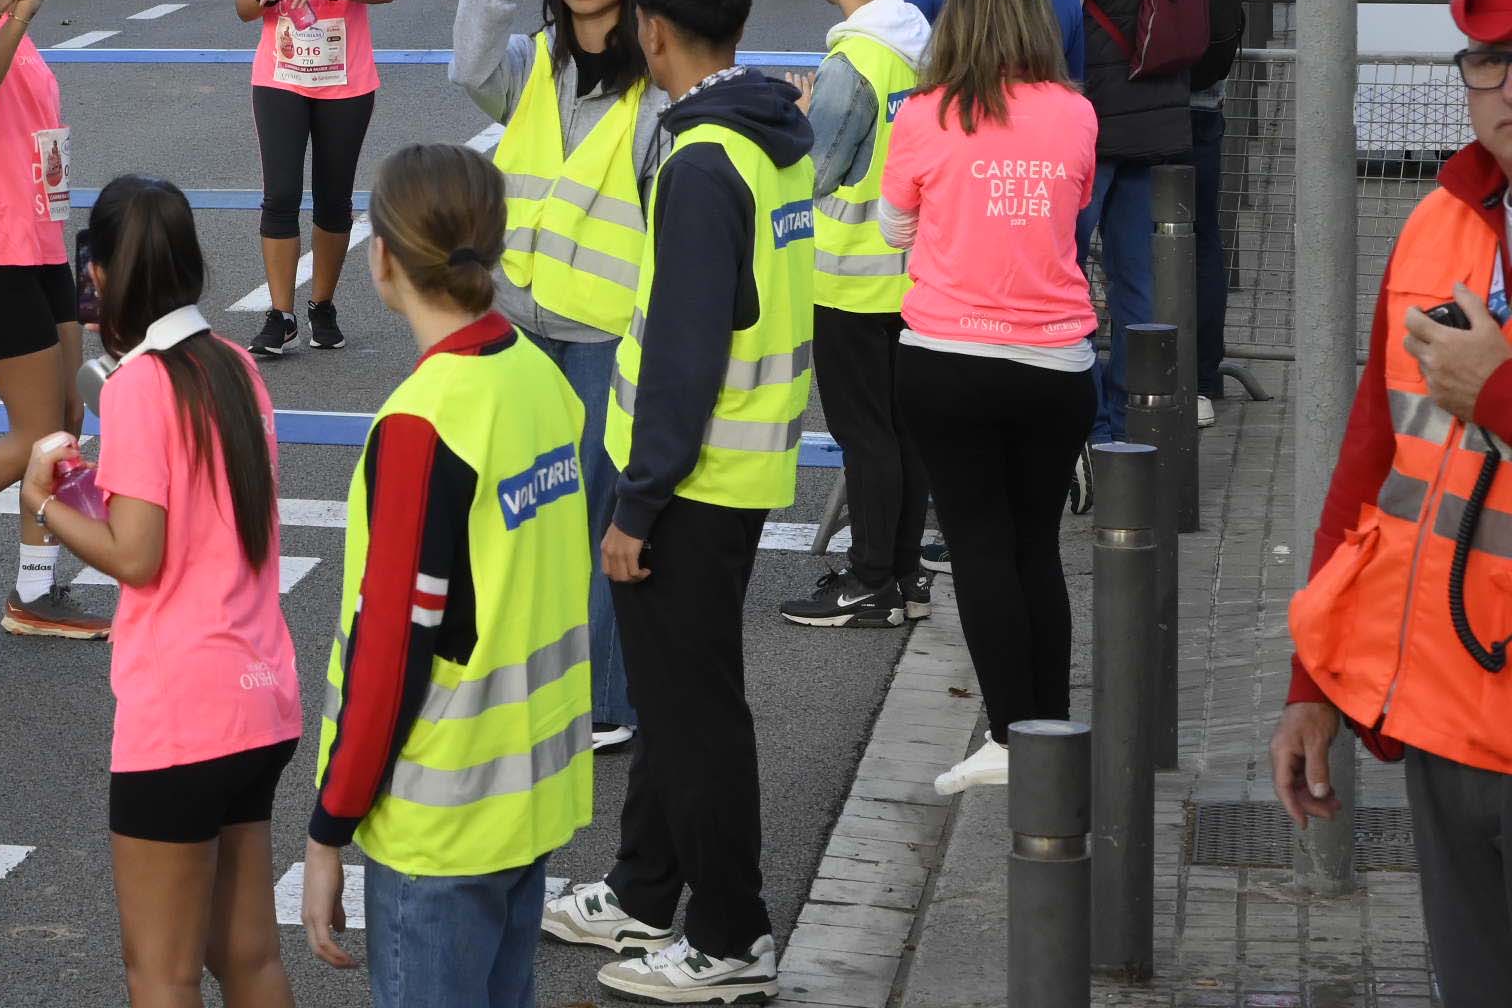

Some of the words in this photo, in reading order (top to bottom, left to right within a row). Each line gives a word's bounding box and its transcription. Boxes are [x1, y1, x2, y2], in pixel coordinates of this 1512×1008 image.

[296, 46, 321, 56] 016
[971, 160, 1068, 180] CARRERA
[990, 180, 1016, 197] DE
[1024, 180, 1049, 198] LA
[987, 199, 1051, 217] MUJER
[960, 316, 1012, 334] OYSHO
[21, 563, 52, 571] adidas
